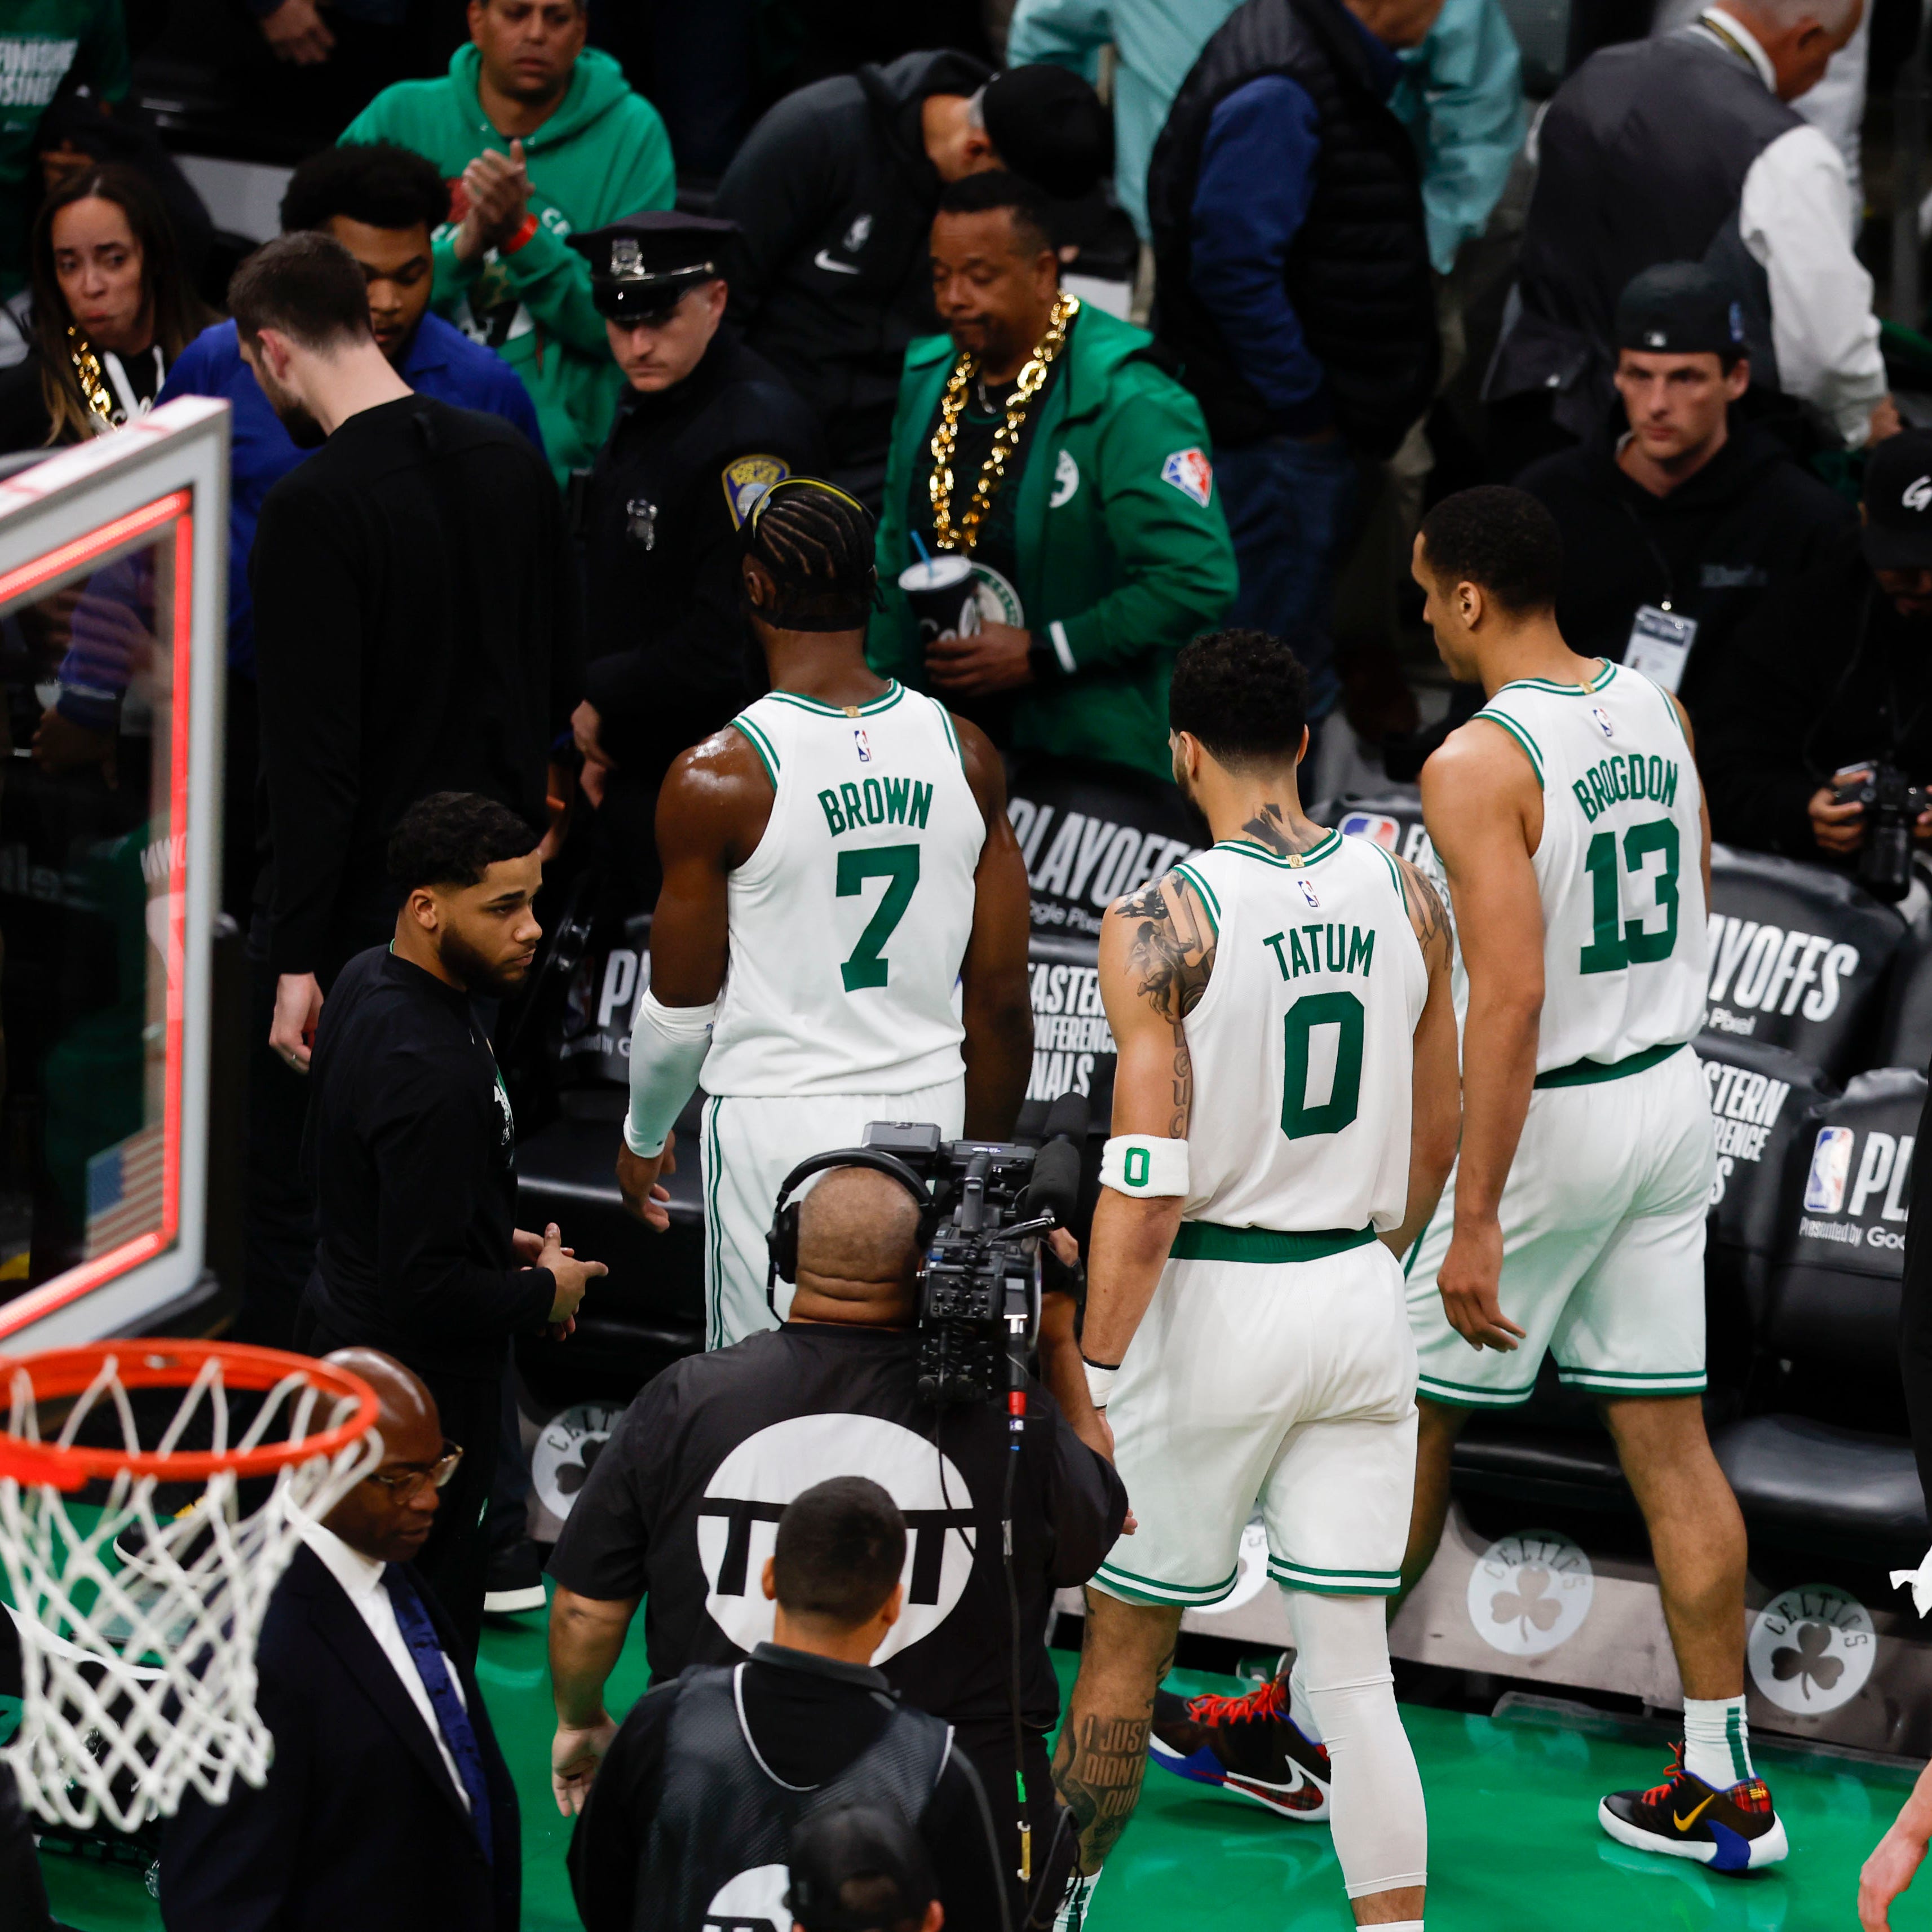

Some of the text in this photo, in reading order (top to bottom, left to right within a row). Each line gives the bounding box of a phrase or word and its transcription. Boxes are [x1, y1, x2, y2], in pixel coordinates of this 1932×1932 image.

[817, 777, 933, 837] BROWN
[1572, 754, 1677, 824] BROGDON
[836, 844, 919, 992] 7
[1580, 817, 1679, 974] 13
[1263, 924, 1375, 981] TATUM
[1280, 991, 1364, 1140] 0
[1125, 1148, 1151, 1187] 0
[1483, 1536, 1587, 1591] CELTICS
[1764, 1591, 1868, 1648] CELTICS
